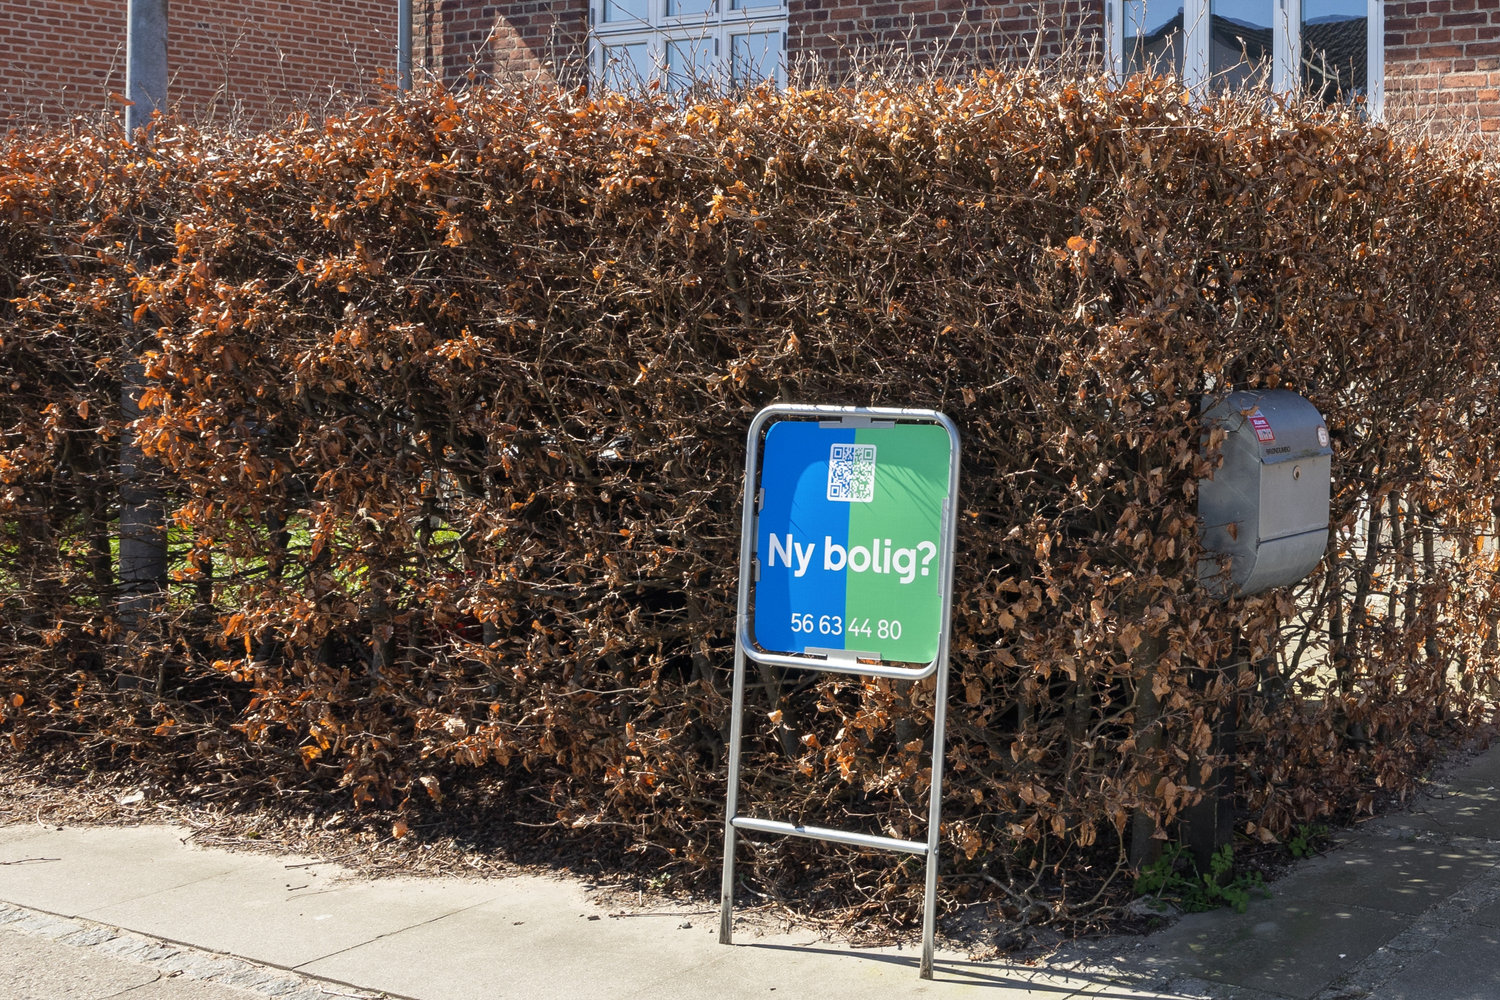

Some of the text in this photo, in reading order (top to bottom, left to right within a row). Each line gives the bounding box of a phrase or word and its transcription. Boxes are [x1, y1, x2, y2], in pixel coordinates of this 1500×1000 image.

[768, 533, 937, 584] Ny bolig?
[790, 613, 902, 640] 56 63 44 80
